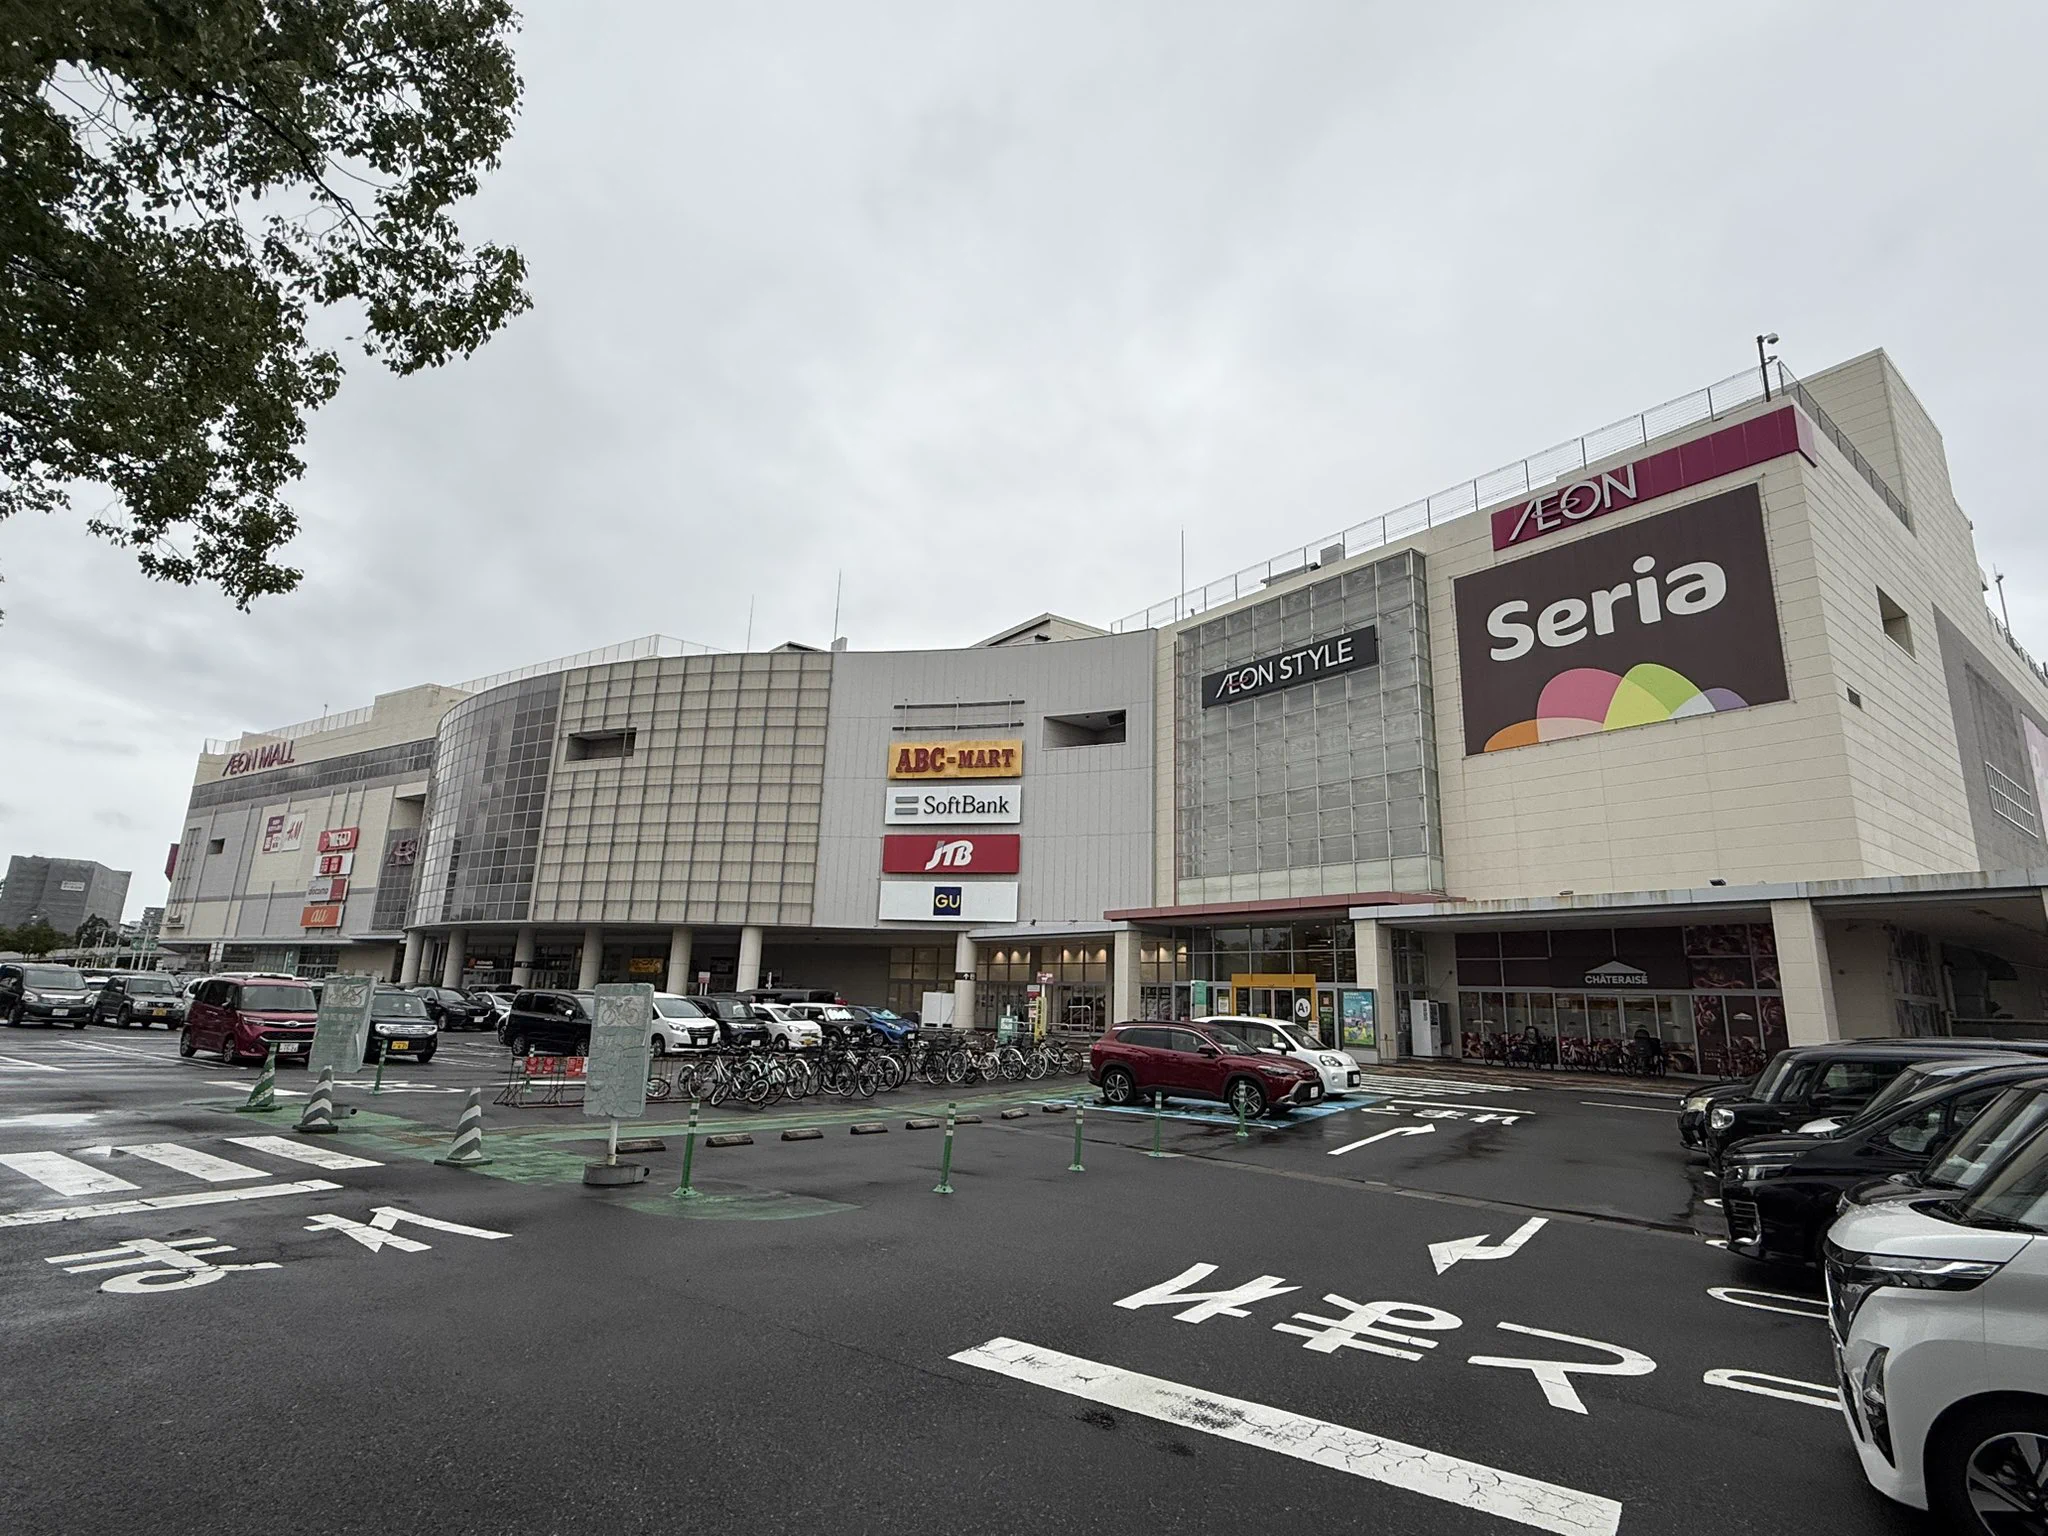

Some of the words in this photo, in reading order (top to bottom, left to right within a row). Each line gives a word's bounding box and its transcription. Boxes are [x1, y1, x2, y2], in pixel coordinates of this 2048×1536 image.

[1484, 555, 1728, 663] Seria
[1279, 637, 1354, 681] STYLE
[259, 740, 295, 769] MALL
[895, 747, 1015, 773] ABC-MART
[923, 795, 1010, 815] SoftBank
[924, 839, 974, 871] JTB
[934, 893, 961, 909] GU
[310, 909, 328, 923] au
[1361, 1105, 1520, 1126] とまれ
[1113, 1262, 1658, 1415] とまれ
